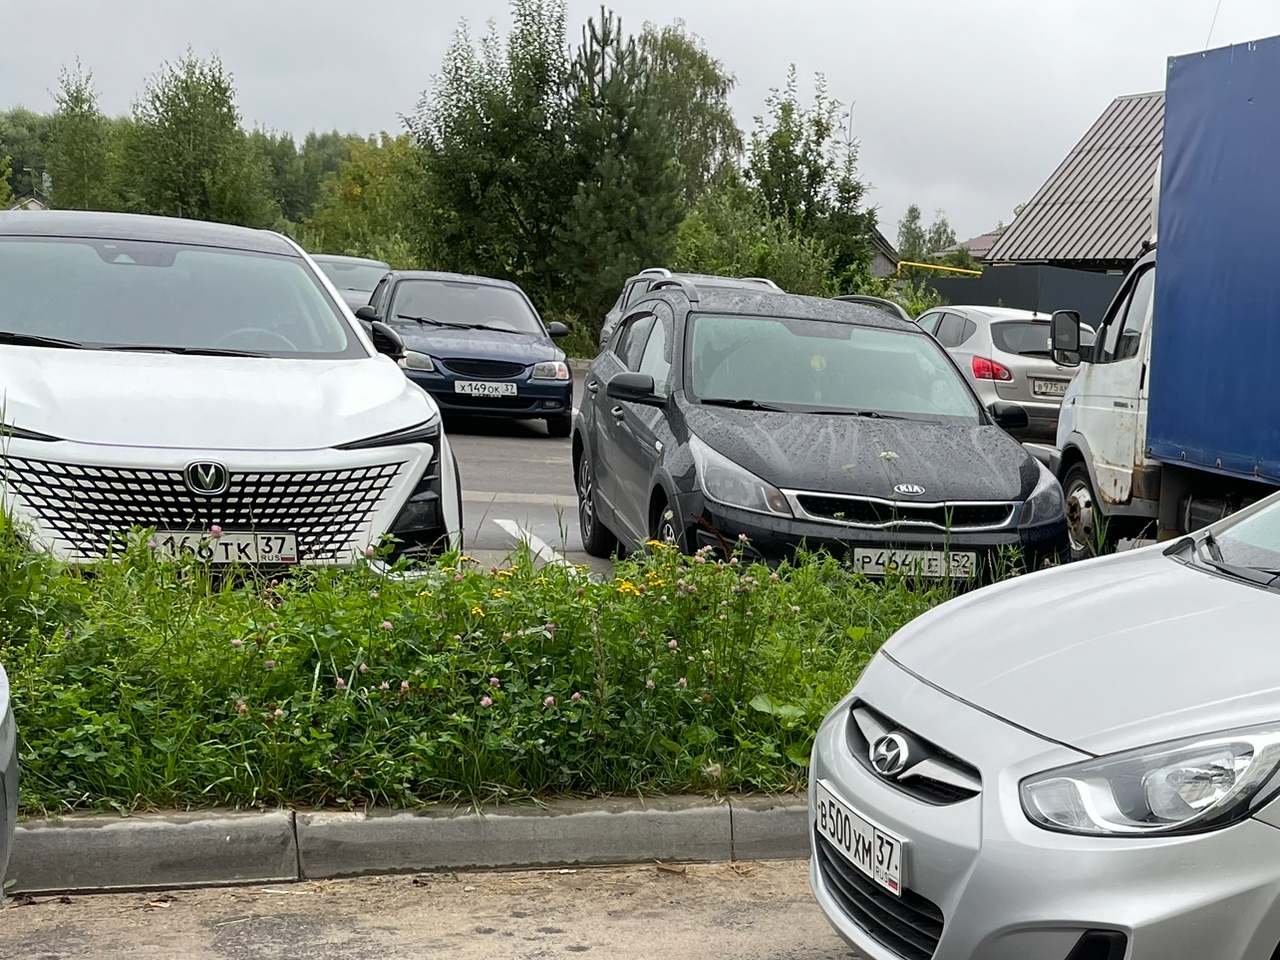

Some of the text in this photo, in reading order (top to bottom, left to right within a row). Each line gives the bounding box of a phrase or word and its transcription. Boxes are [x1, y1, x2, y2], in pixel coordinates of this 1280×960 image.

[162, 535, 287, 562] 166ТК 37
[260, 554, 281, 562] RUS
[952, 553, 970, 568] 52
[876, 834, 894, 871] 37
